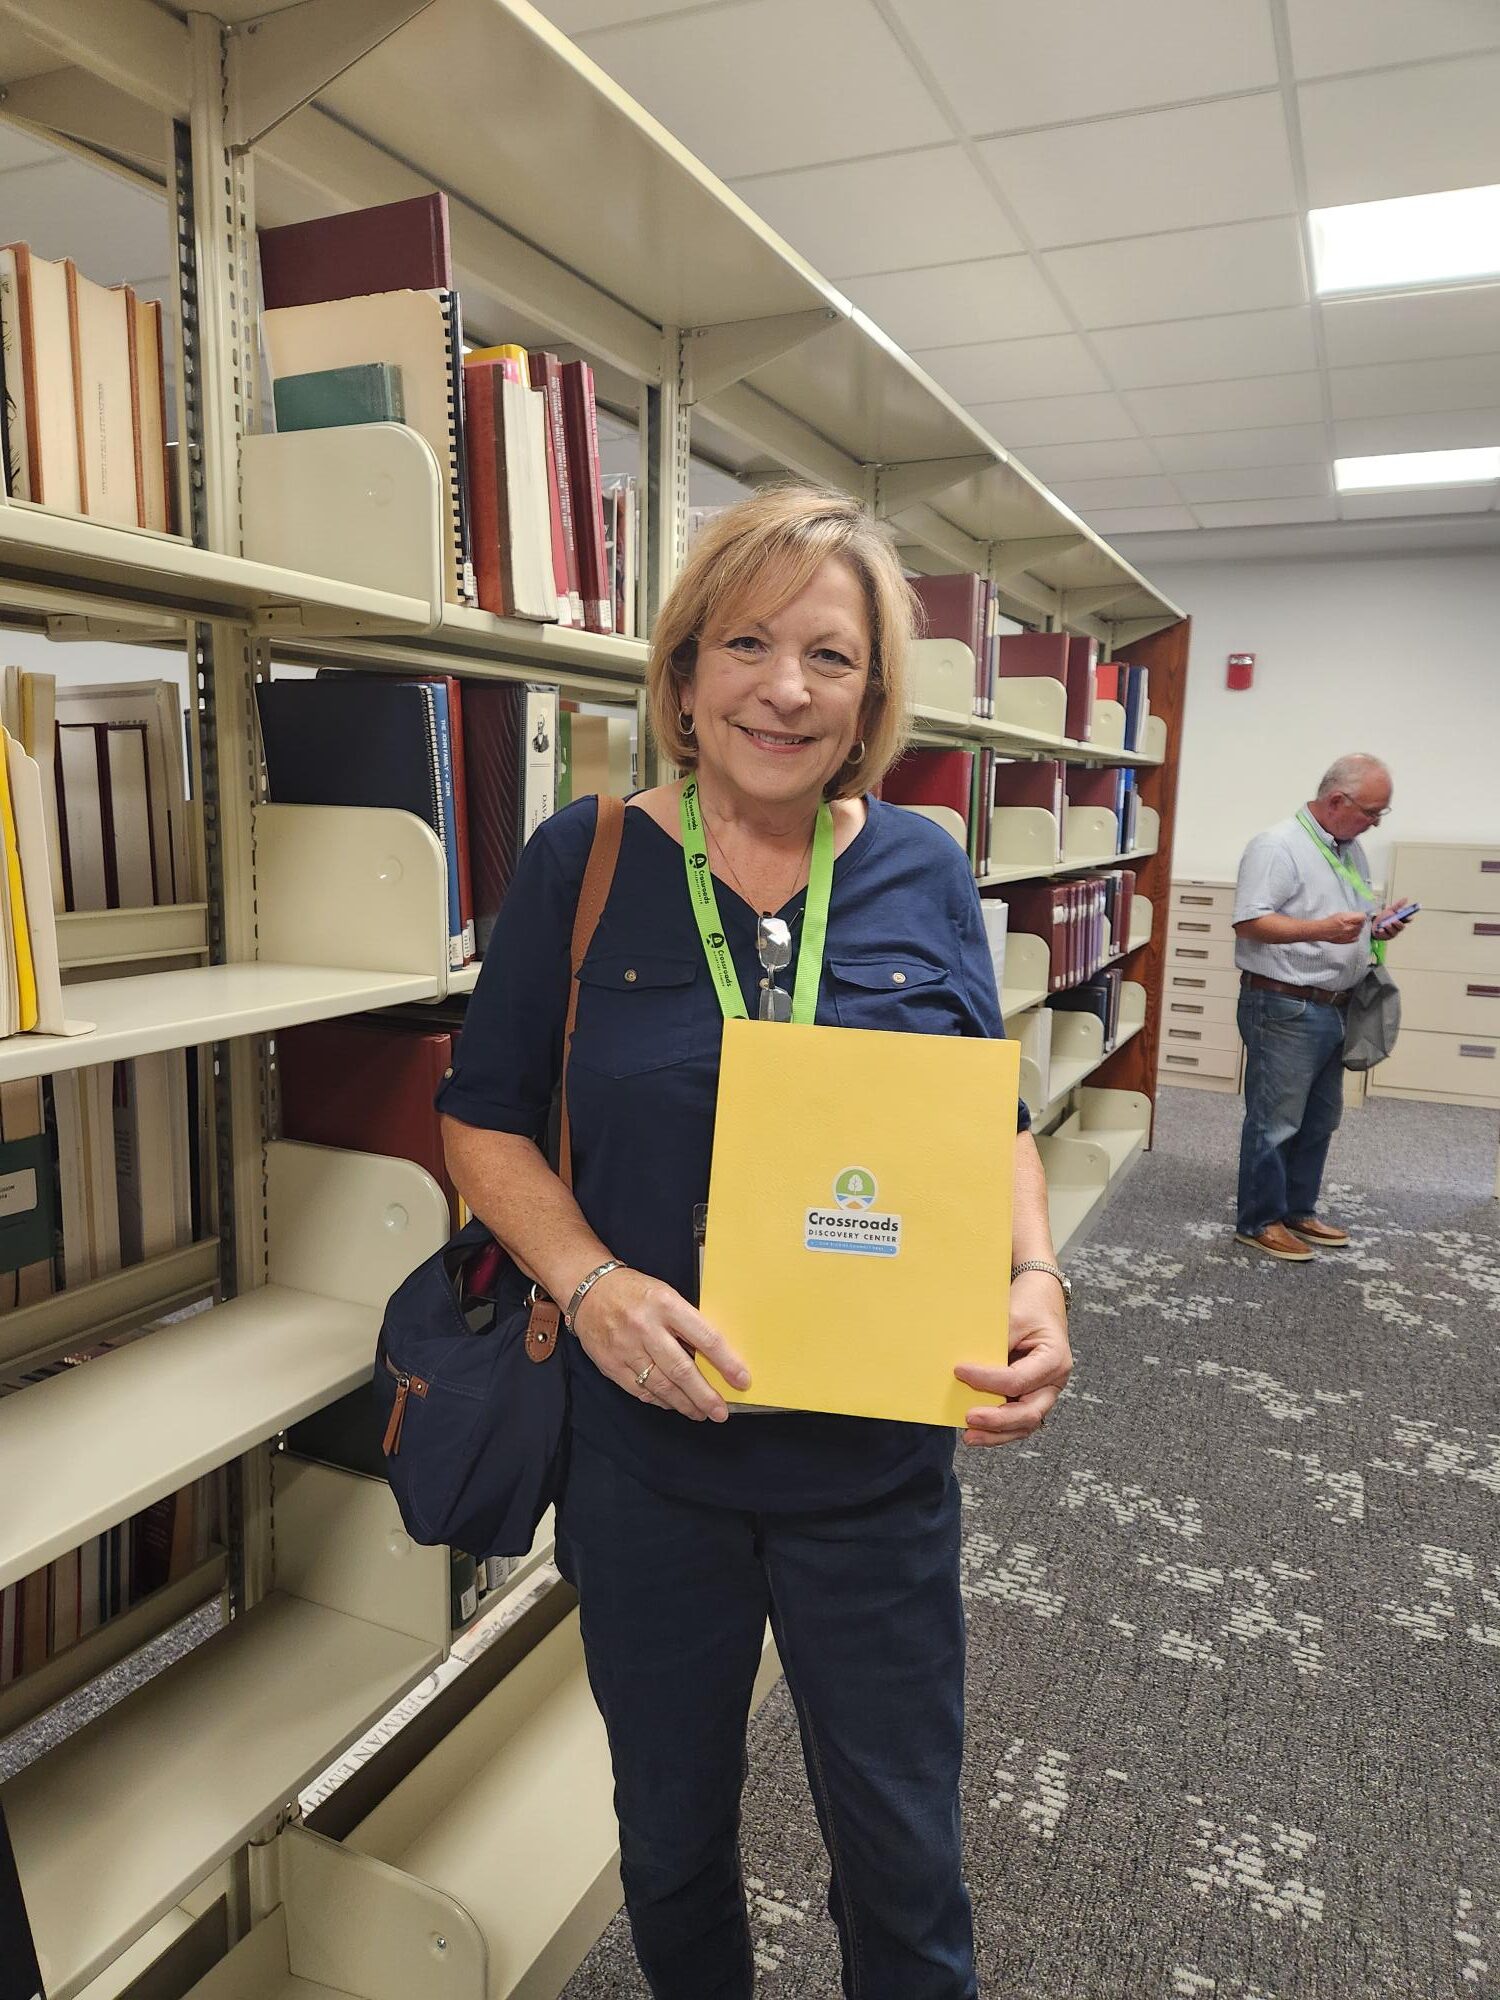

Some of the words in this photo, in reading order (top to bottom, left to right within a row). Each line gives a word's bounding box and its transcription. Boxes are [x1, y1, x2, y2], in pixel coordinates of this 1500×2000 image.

[699, 870, 711, 904] Crossroads
[718, 949, 732, 987] Crossroads
[808, 1212, 899, 1232] Crossroads
[808, 1229, 860, 1239] DISCOVERY
[863, 1233, 897, 1242] CENTER
